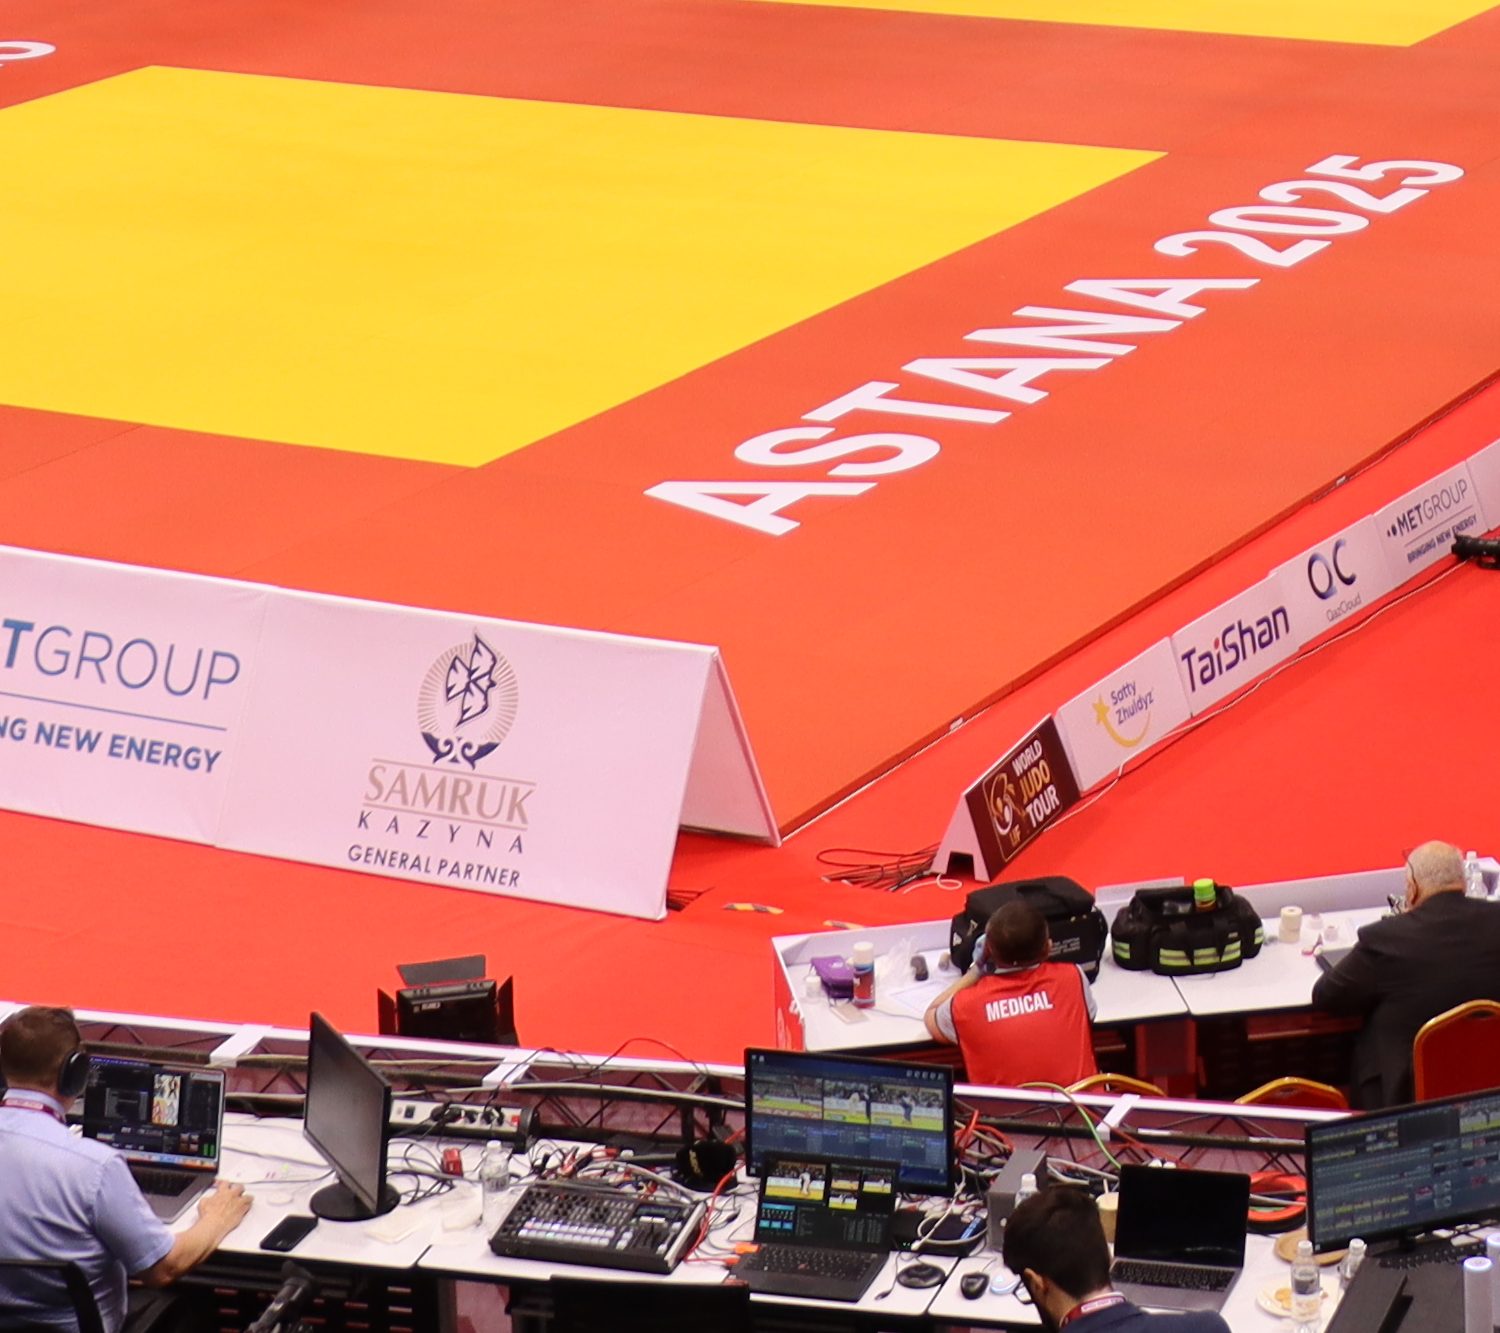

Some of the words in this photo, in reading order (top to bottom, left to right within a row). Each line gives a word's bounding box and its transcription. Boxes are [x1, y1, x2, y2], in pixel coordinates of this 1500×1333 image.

[644, 277, 1261, 536] ASTANA
[1153, 154, 1464, 267] 2025
[1396, 478, 1469, 536] METGROUP
[1308, 539, 1356, 601] QC
[1326, 593, 1362, 622] QazCloud
[1181, 605, 1290, 693] TaiShan
[32, 720, 102, 753] NEW
[107, 730, 222, 776] ENERGY
[1011, 739, 1043, 777] WORLD
[362, 762, 535, 827] SAMRUK
[1019, 760, 1051, 802] JUDO
[1026, 784, 1060, 828] TOUR
[356, 811, 526, 855] KAZYNA
[346, 843, 433, 876] GENERAL
[436, 857, 520, 888] PARTNER
[985, 991, 1053, 1022] MEDICAL
